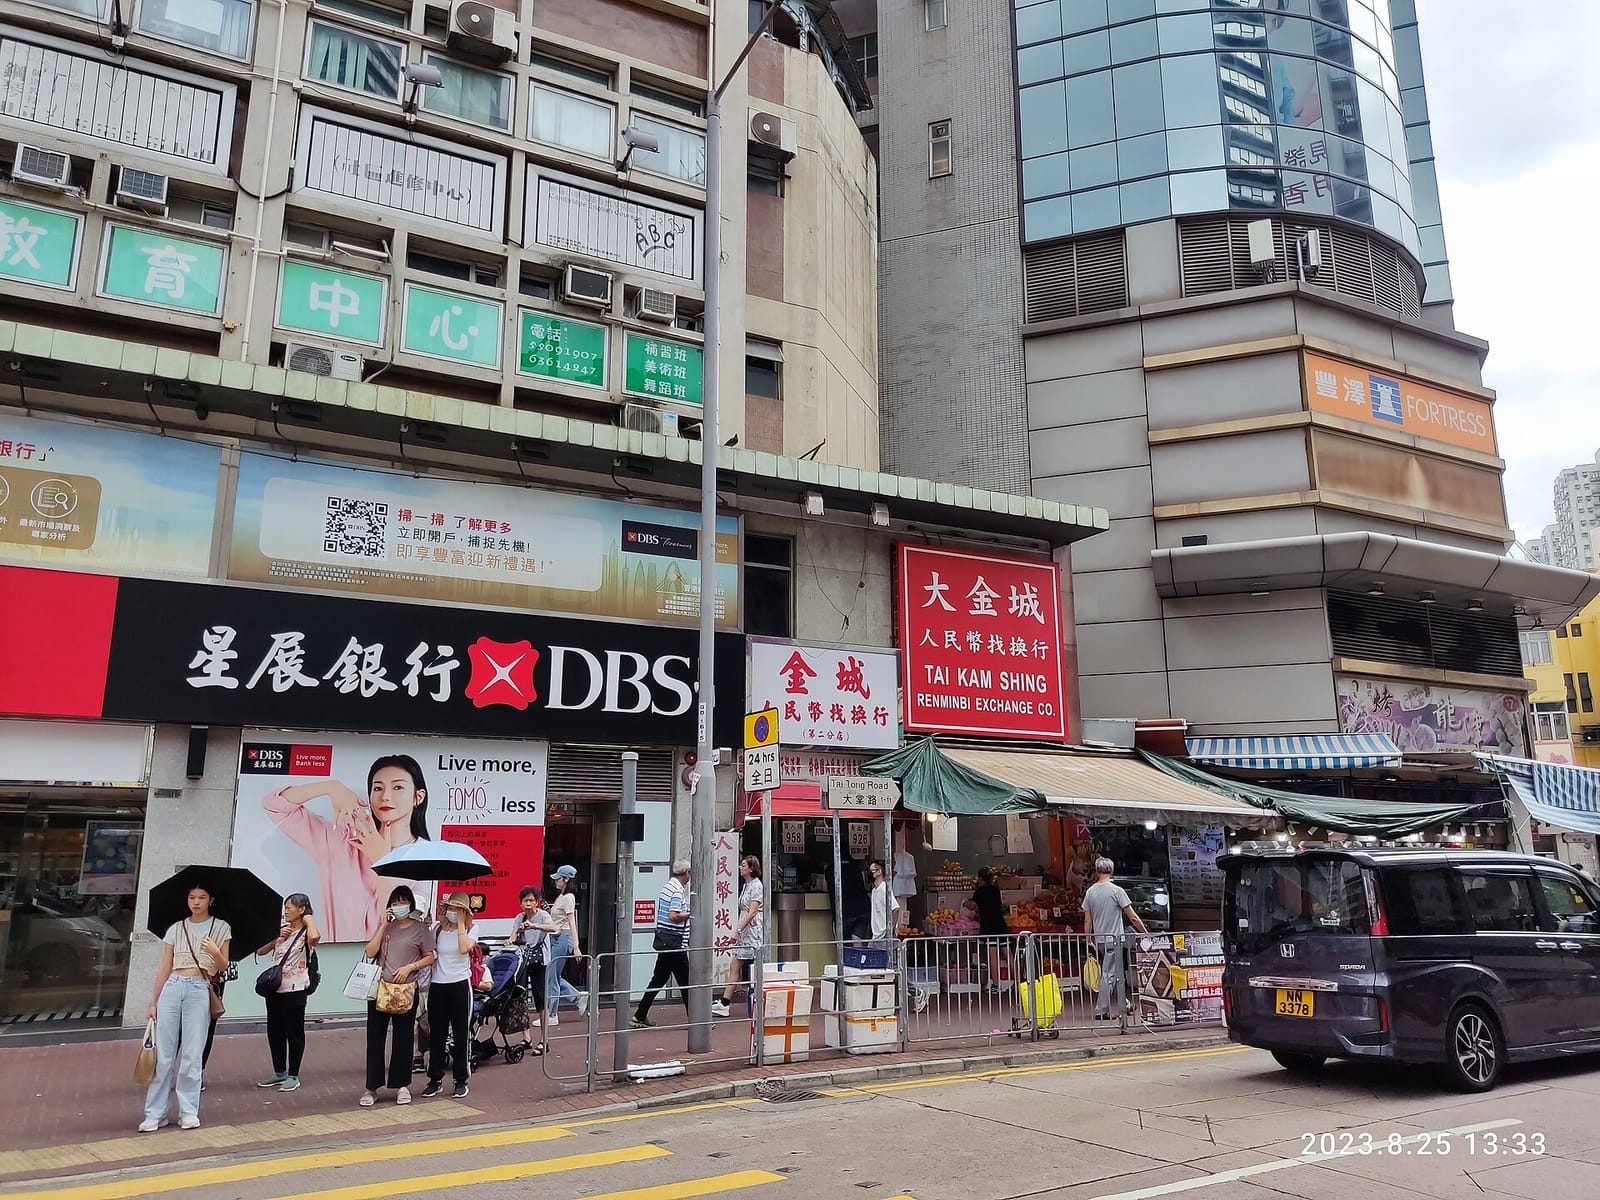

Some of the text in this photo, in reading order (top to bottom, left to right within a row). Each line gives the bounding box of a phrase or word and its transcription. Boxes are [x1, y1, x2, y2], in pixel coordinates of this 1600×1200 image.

[645, 341, 688, 362] 補習班
[644, 359, 687, 379] 美術班
[643, 378, 687, 398] 舞蹈班
[1315, 368, 1366, 406] 豐澤
[1407, 395, 1487, 438] FORTRESS
[397, 508, 513, 534] 掃一掃 了解更多
[638, 532, 659, 545] DBS
[921, 571, 1046, 625] 大金城
[919, 629, 1049, 660] 人民幣找換行
[186, 625, 460, 703] 星展銀行
[544, 645, 693, 716] DBS
[779, 651, 872, 700] 金城
[924, 664, 1047, 693] TAI KAM SHING
[917, 693, 1056, 717] RENMINBI EXCHANGE CO.
[259, 750, 283, 760] DBS
[438, 754, 537, 776] Live more,
[748, 752, 775, 765] 24 hrs
[751, 768, 772, 786] 全日
[868, 780, 889, 790] Road
[447, 786, 536, 813] FOMO less
[843, 794, 877, 806] 大棠路
[1286, 990, 1303, 1003] NN
[1279, 1001, 1309, 1016] 3378
